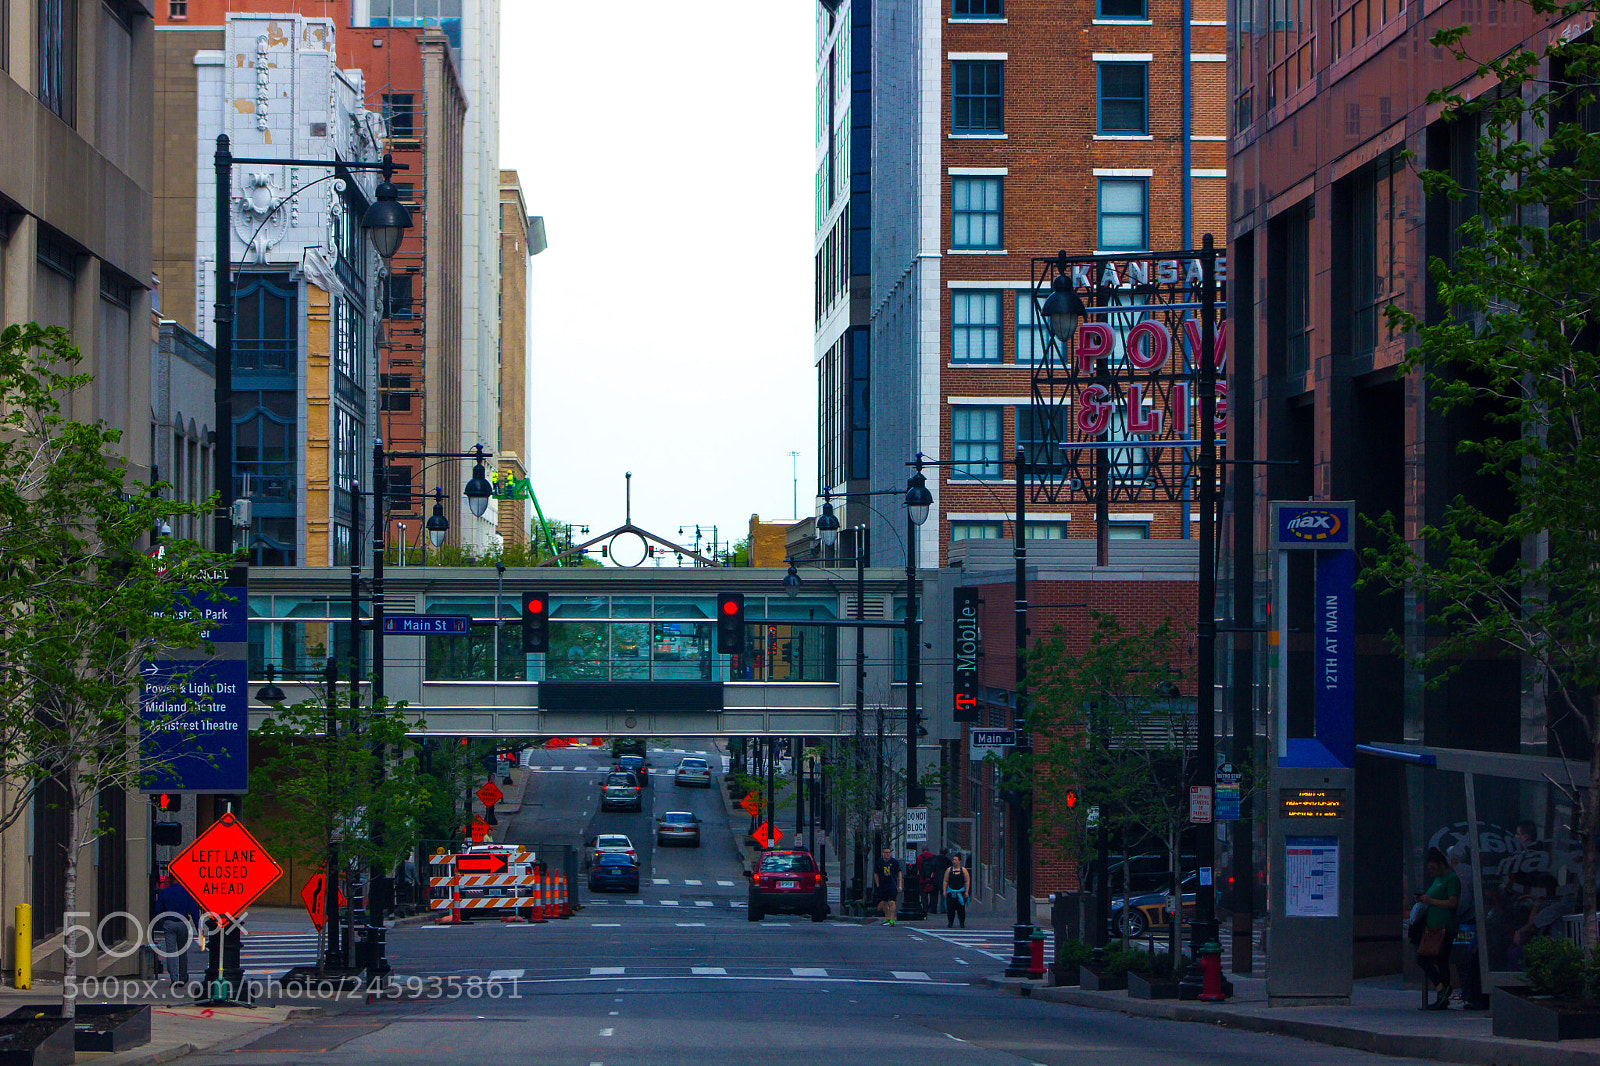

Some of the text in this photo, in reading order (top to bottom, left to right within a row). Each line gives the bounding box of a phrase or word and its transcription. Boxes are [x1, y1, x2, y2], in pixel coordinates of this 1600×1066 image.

[1077, 384, 1115, 437] &
[1286, 515, 1331, 530] max
[205, 608, 228, 620] Park
[403, 619, 431, 630] Main
[435, 620, 447, 631] St
[1325, 595, 1338, 690] 12TH AT MAIN
[216, 682, 237, 694] Dist
[145, 701, 226, 713] Midland heatre
[978, 733, 1002, 744] Main
[907, 812, 926, 820] DO NOT
[907, 823, 926, 832] BLOCK
[192, 850, 256, 862] LEFT LANE
[199, 866, 248, 878] CLOSED
[203, 883, 244, 894] AHEAD
